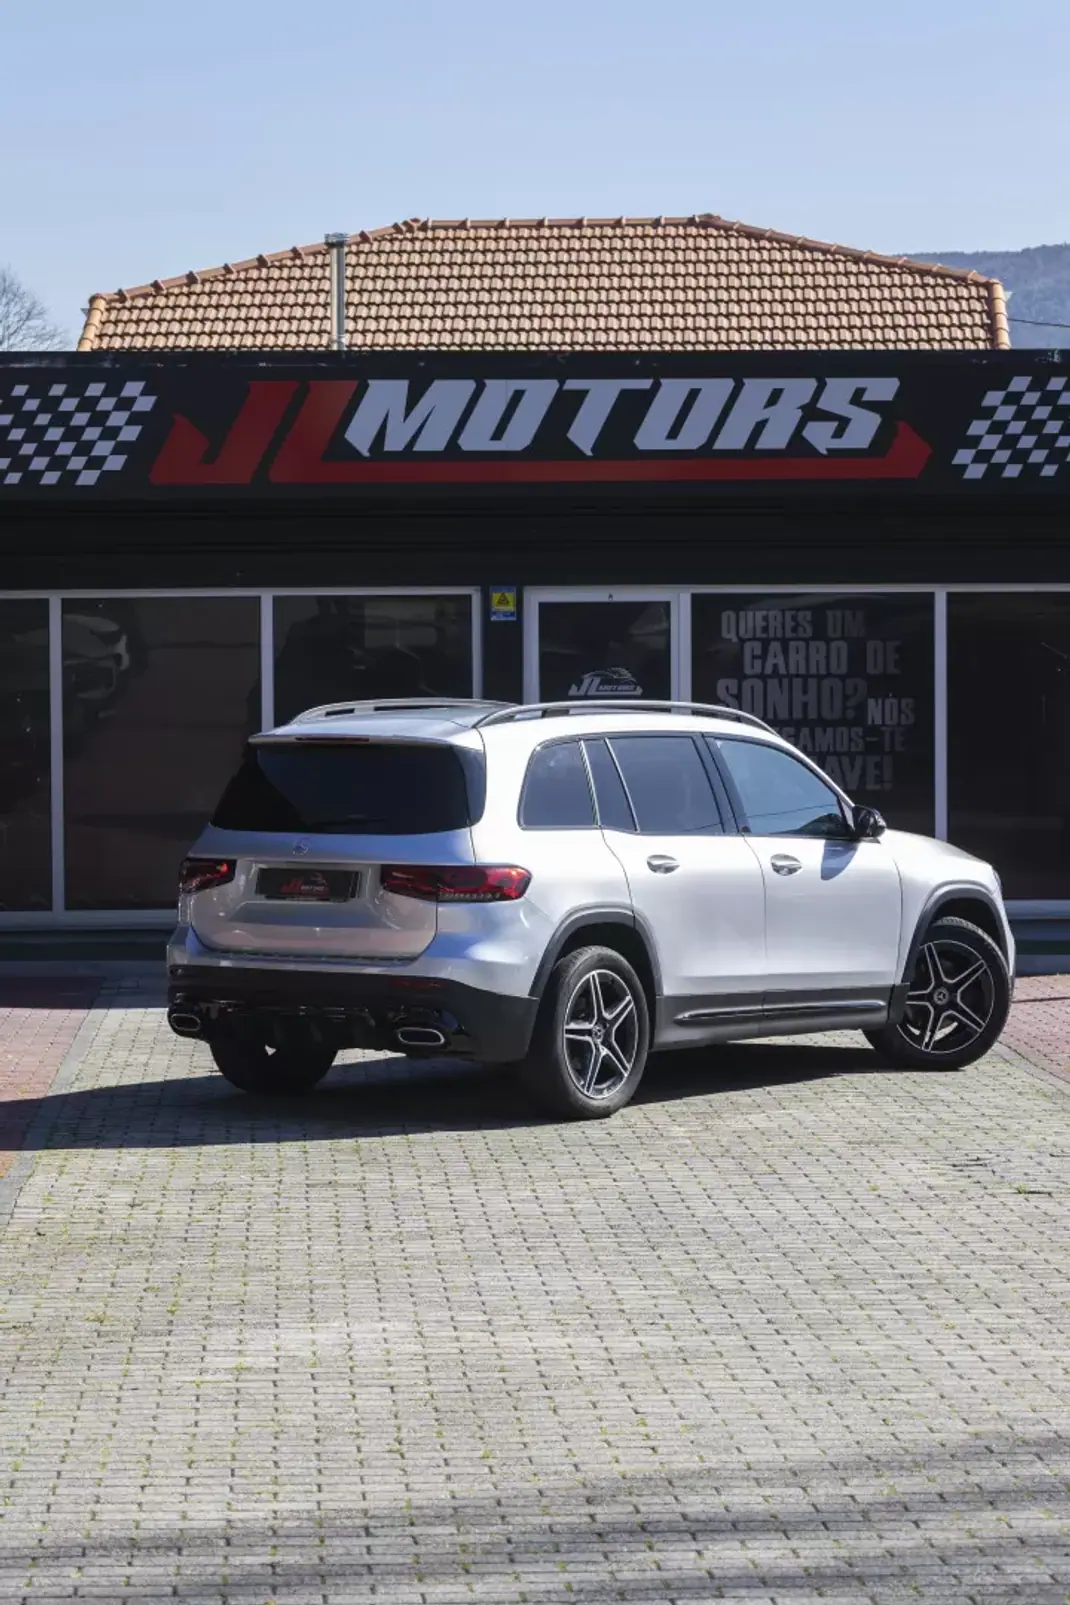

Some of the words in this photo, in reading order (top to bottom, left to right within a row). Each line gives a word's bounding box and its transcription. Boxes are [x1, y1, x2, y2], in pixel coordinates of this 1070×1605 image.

[344, 377, 900, 458] MOTORS
[721, 610, 813, 642] QUERES
[826, 610, 867, 638] UM
[743, 640, 848, 675] CARRO
[866, 640, 902, 675] DE
[716, 678, 868, 720] SONHO?
